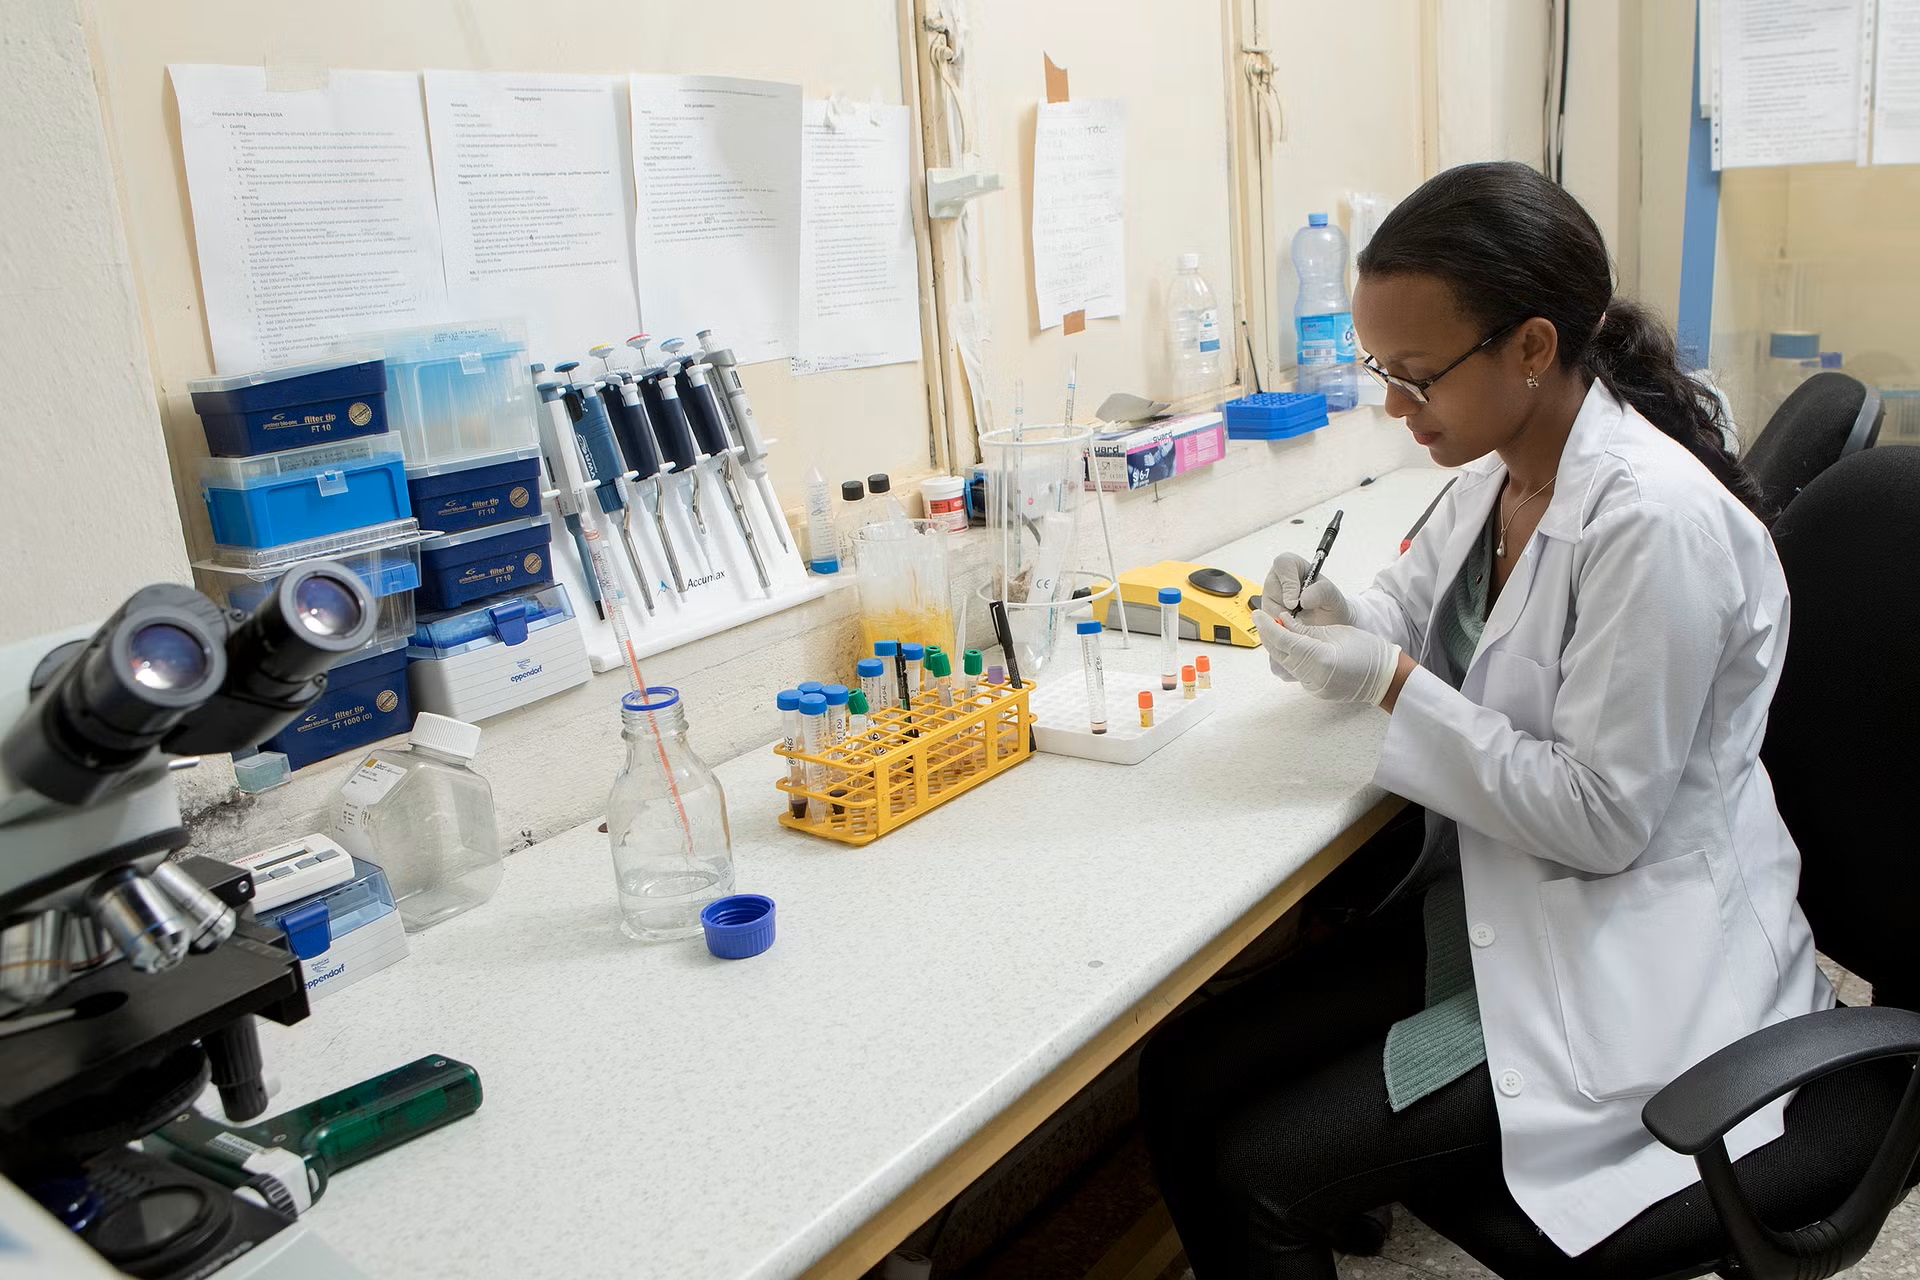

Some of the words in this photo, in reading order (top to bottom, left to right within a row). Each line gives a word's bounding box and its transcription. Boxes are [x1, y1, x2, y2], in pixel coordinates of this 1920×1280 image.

[325, 413, 336, 422] tip
[511, 665, 542, 682] eppendorf
[354, 706, 364, 714] tip
[332, 722, 340, 730] FT
[344, 716, 360, 726] 1000
